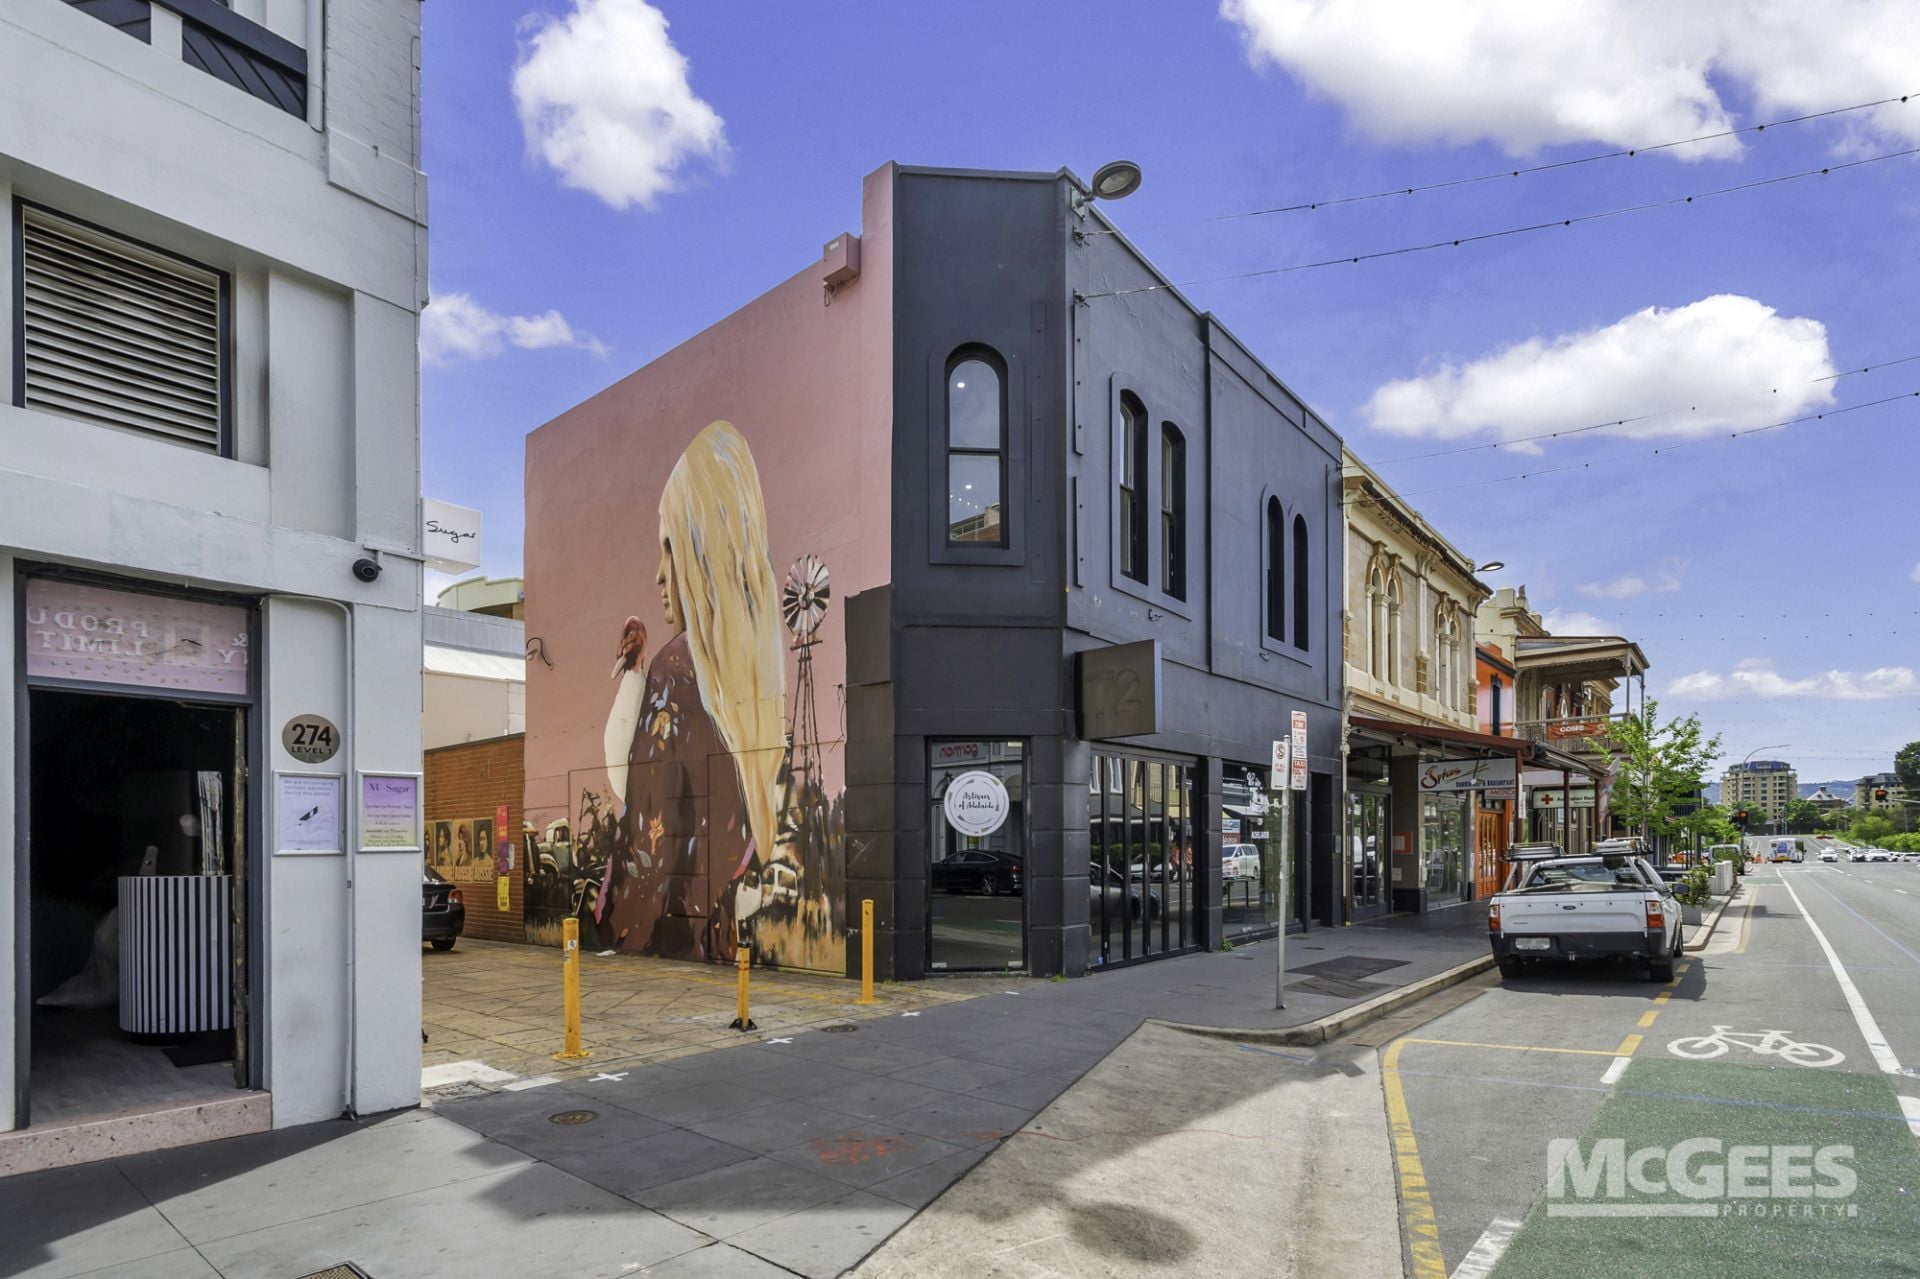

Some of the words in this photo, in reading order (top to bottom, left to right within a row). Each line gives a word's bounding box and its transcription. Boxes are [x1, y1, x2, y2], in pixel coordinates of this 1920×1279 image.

[426, 520, 476, 543] Sugar
[291, 723, 332, 747] 274
[291, 746, 326, 755] LEVEL
